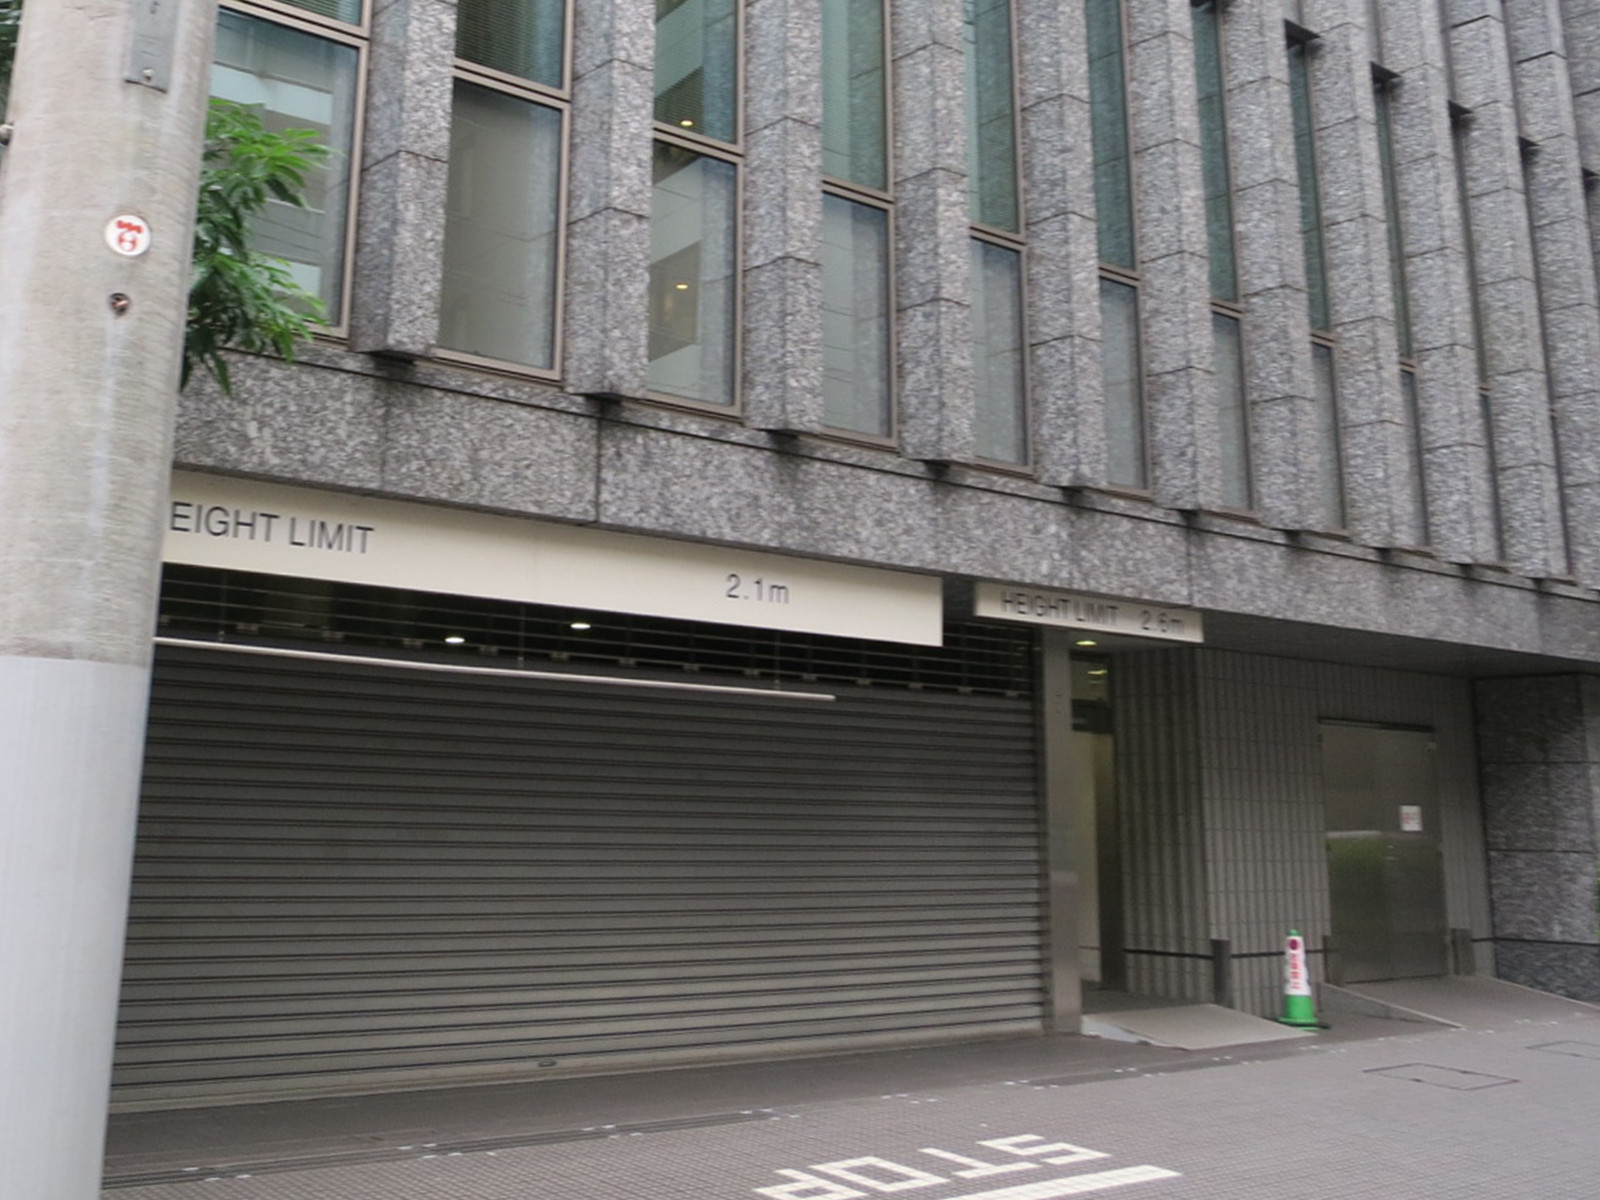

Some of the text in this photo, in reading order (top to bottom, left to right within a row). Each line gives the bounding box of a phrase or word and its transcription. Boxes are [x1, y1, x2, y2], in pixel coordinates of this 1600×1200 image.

[170, 500, 375, 554] EIGHT LIMIT
[725, 572, 790, 605] 2.1m
[1000, 590, 1070, 621] HEIGHT
[1073, 599, 1119, 627] LIMIT
[752, 1133, 1113, 1200] STOP
